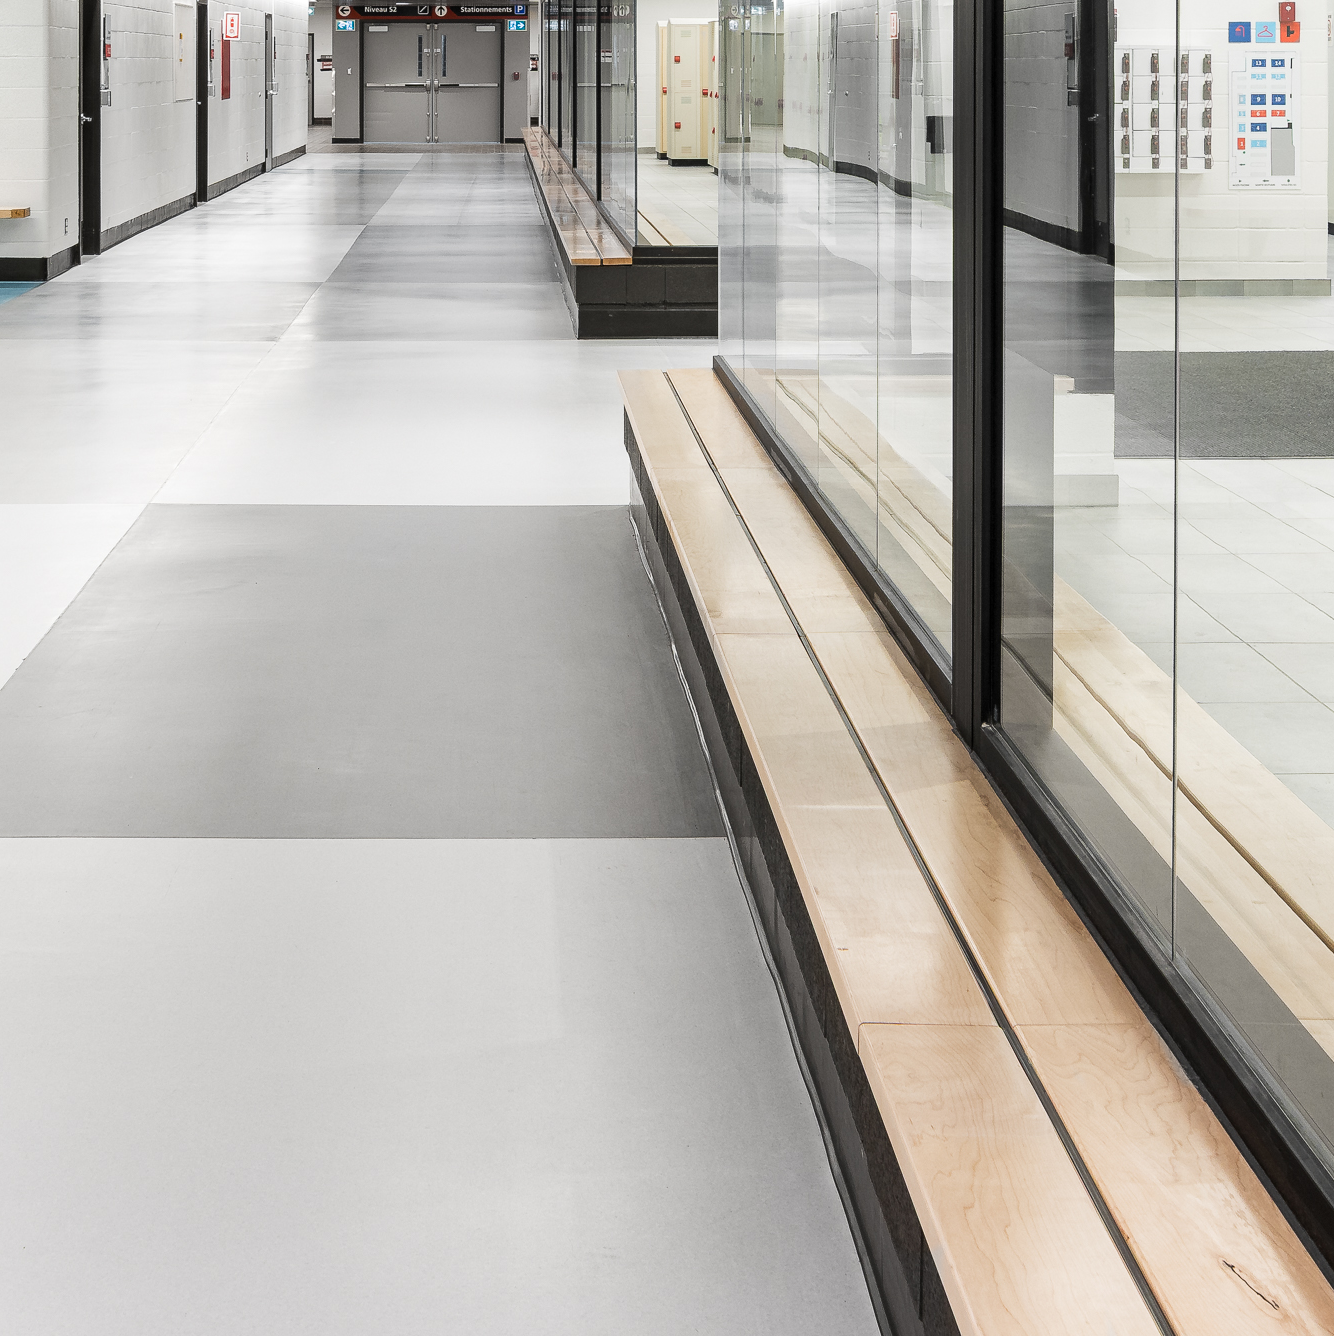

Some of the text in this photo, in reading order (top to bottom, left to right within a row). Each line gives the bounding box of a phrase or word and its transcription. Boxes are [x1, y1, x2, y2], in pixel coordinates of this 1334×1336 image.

[364, 5, 398, 13] Niveau S2
[460, 5, 513, 13] Stationnements
